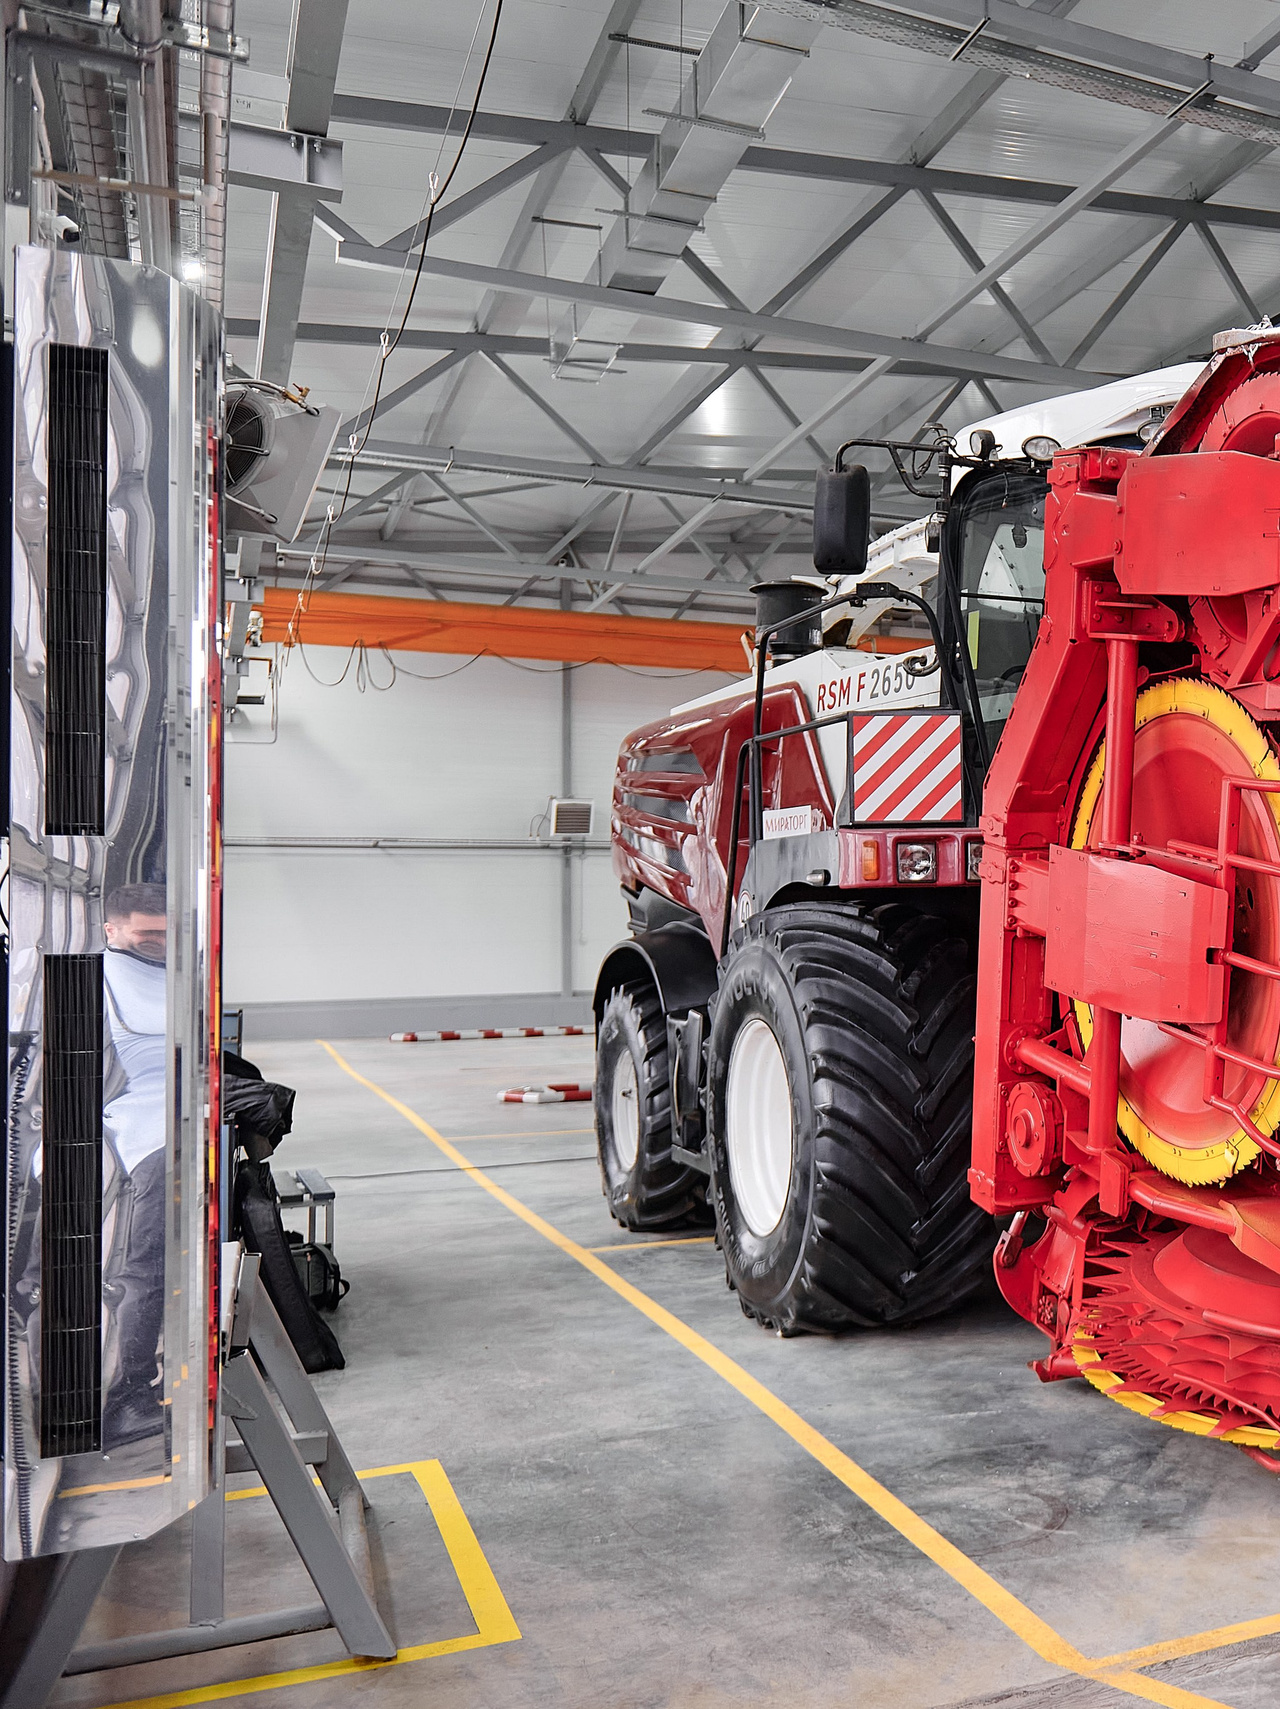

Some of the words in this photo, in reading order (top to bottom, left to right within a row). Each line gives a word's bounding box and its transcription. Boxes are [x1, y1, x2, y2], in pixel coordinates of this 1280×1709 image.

[816, 676, 852, 713] RSM
[856, 672, 867, 703] F
[765, 813, 808, 833] МИРАТОРГ
